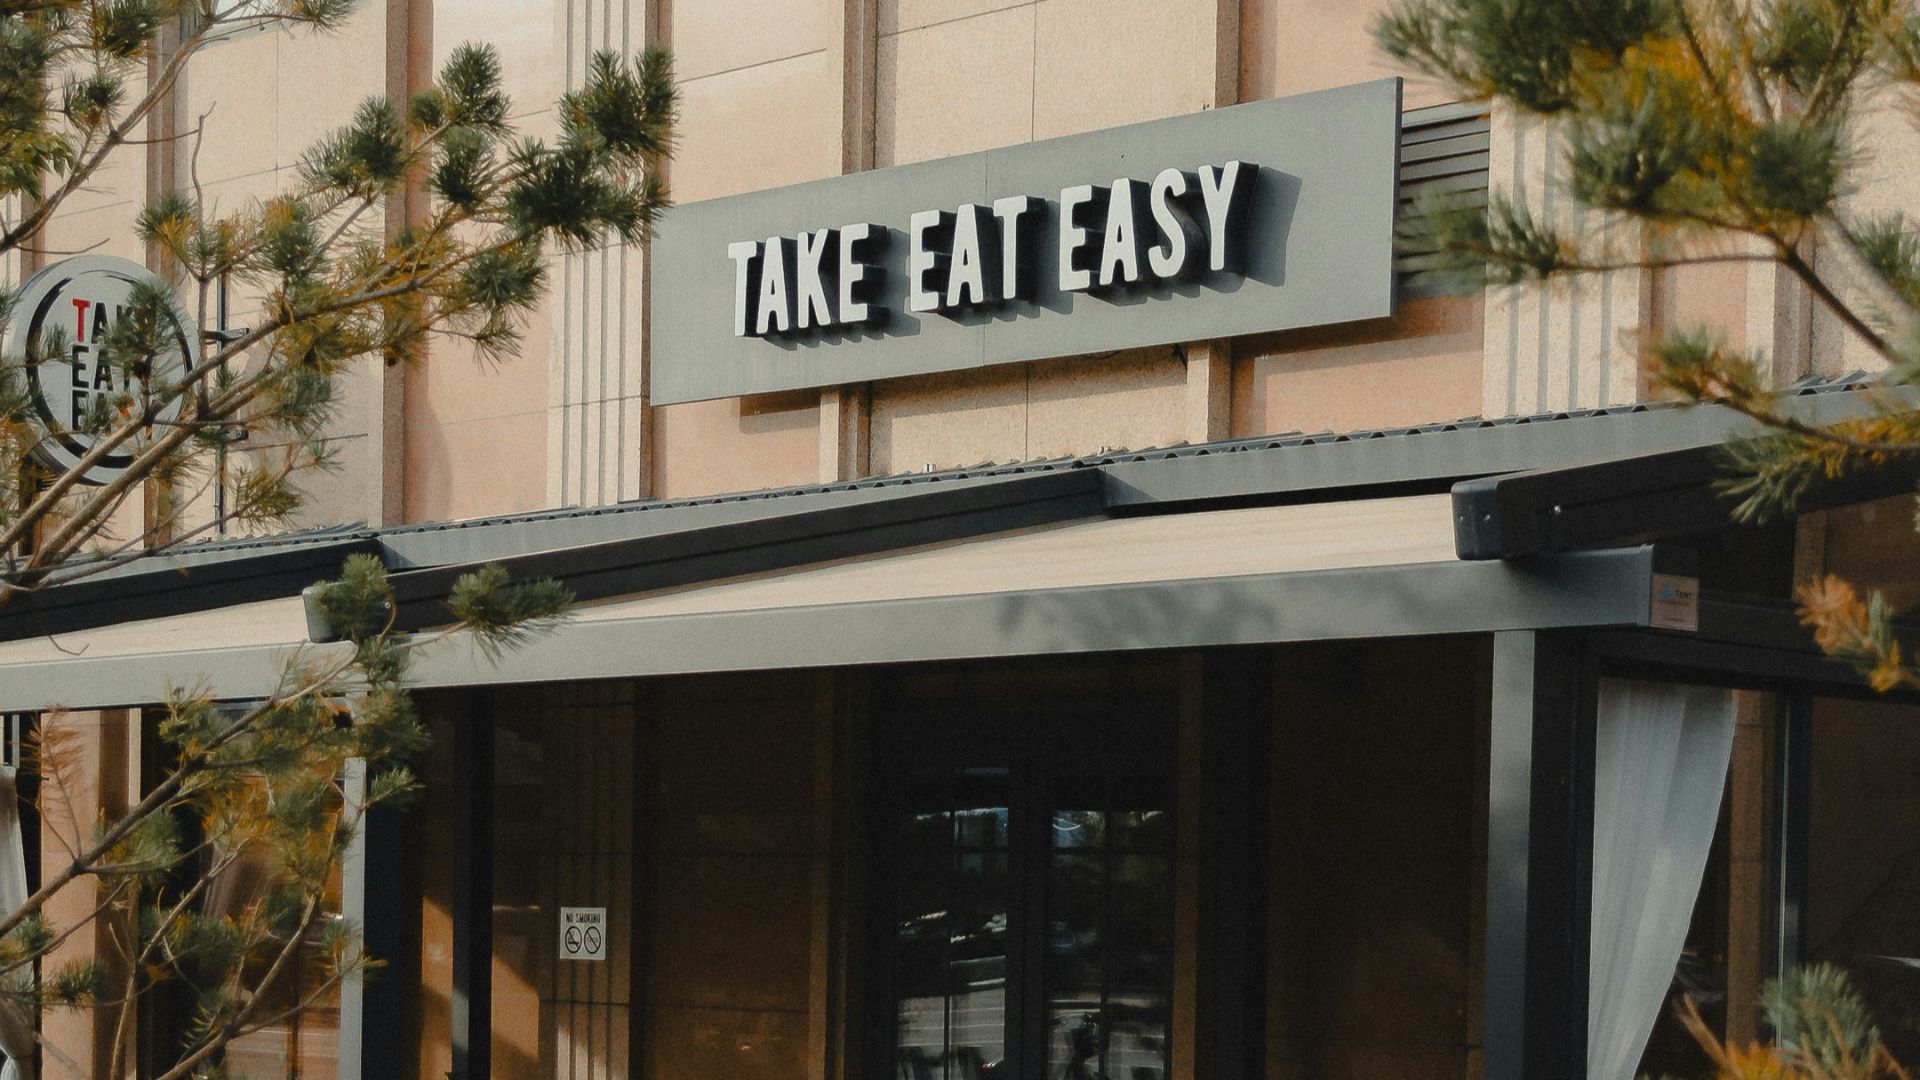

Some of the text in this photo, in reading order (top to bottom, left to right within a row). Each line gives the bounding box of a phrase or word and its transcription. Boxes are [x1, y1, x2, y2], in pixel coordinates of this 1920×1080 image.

[727, 160, 1240, 337] TAKE EAT EASY
[72, 298, 140, 345] TA
[72, 344, 135, 392] EA
[566, 912, 601, 924] NO SMOKING
